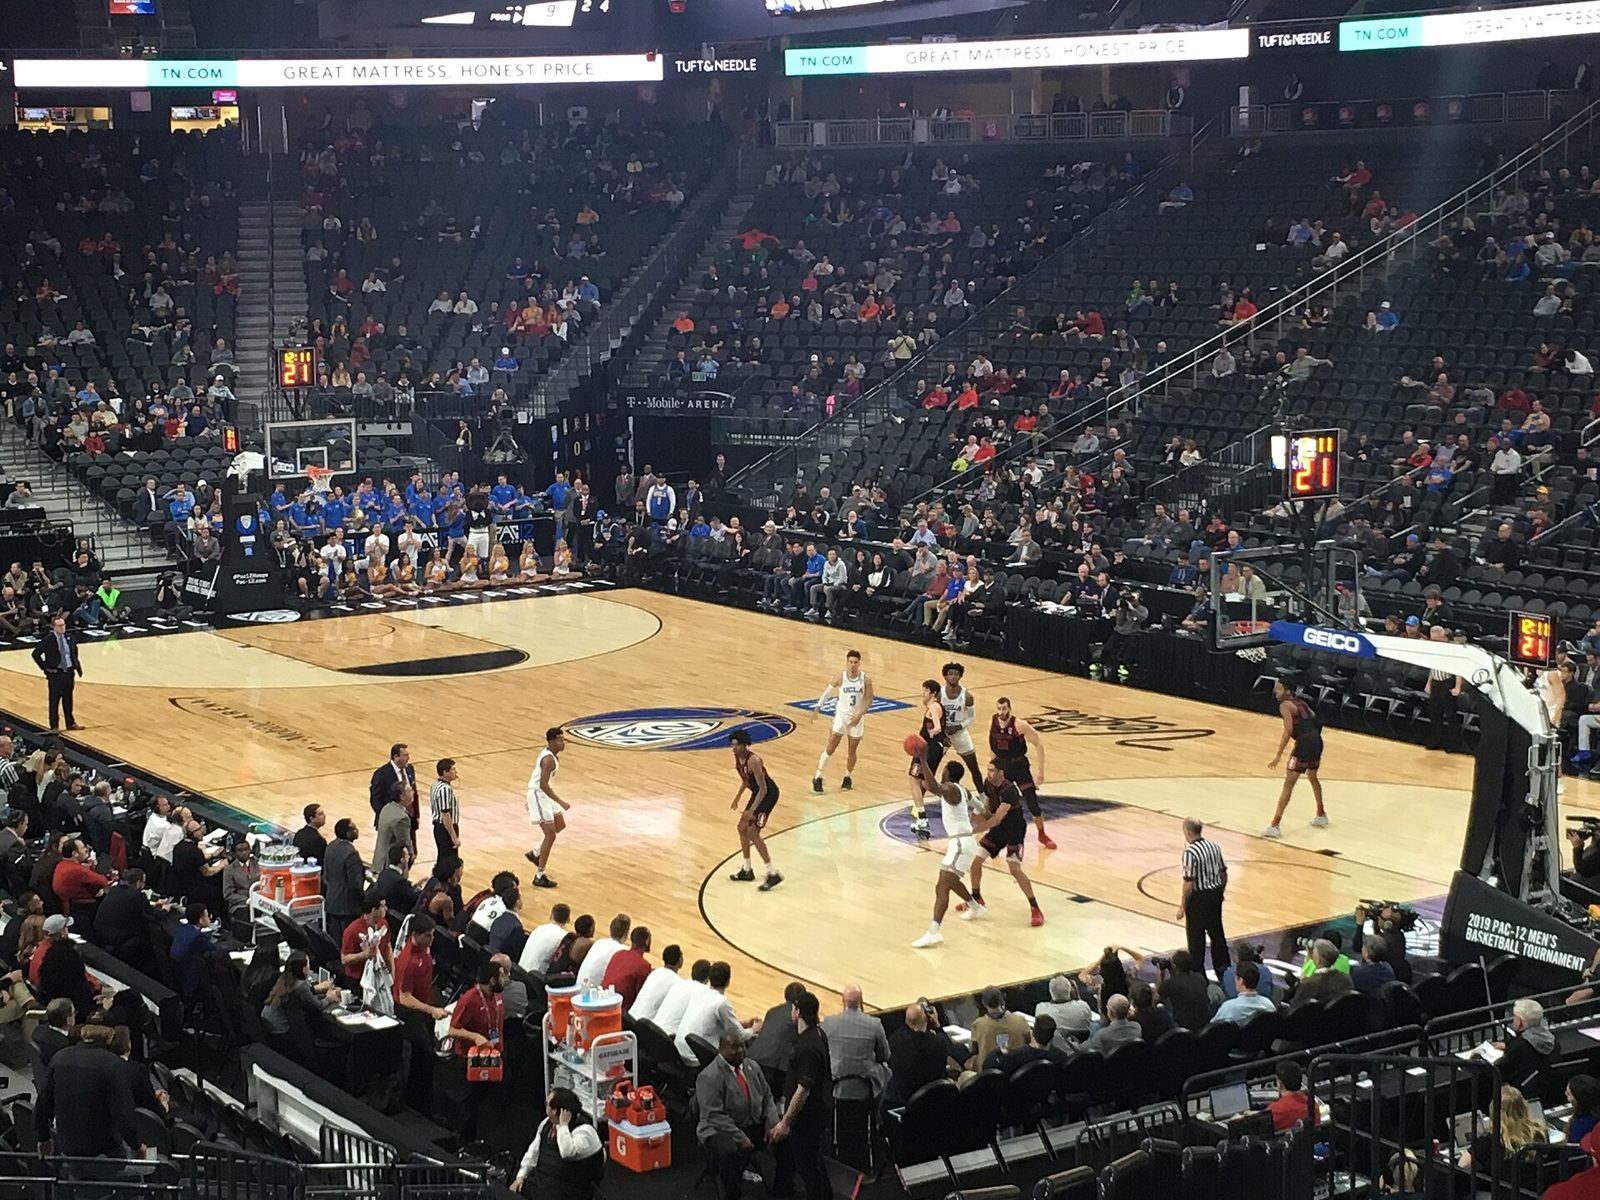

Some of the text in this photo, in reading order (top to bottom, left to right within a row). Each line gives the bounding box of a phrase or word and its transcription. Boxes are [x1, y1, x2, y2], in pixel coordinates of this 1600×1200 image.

[1138, 39, 1186, 54] PRCE
[1258, 31, 1332, 48] TUFT&NEEDLE
[283, 65, 344, 80] GREAT
[461, 63, 535, 77] HONEST
[675, 59, 758, 73] TUFT&NEEDLE
[284, 364, 309, 384] 21
[1303, 628, 1361, 653] GEICO
[1522, 635, 1544, 657] 21
[843, 686, 864, 694] UCLA
[850, 695, 856, 706] 3
[1467, 912, 1559, 949] 2019 PAC-12 MEN'S
[1465, 926, 1586, 972] BASKETBALL TOURNAMENT
[616, 1135, 627, 1156] G
